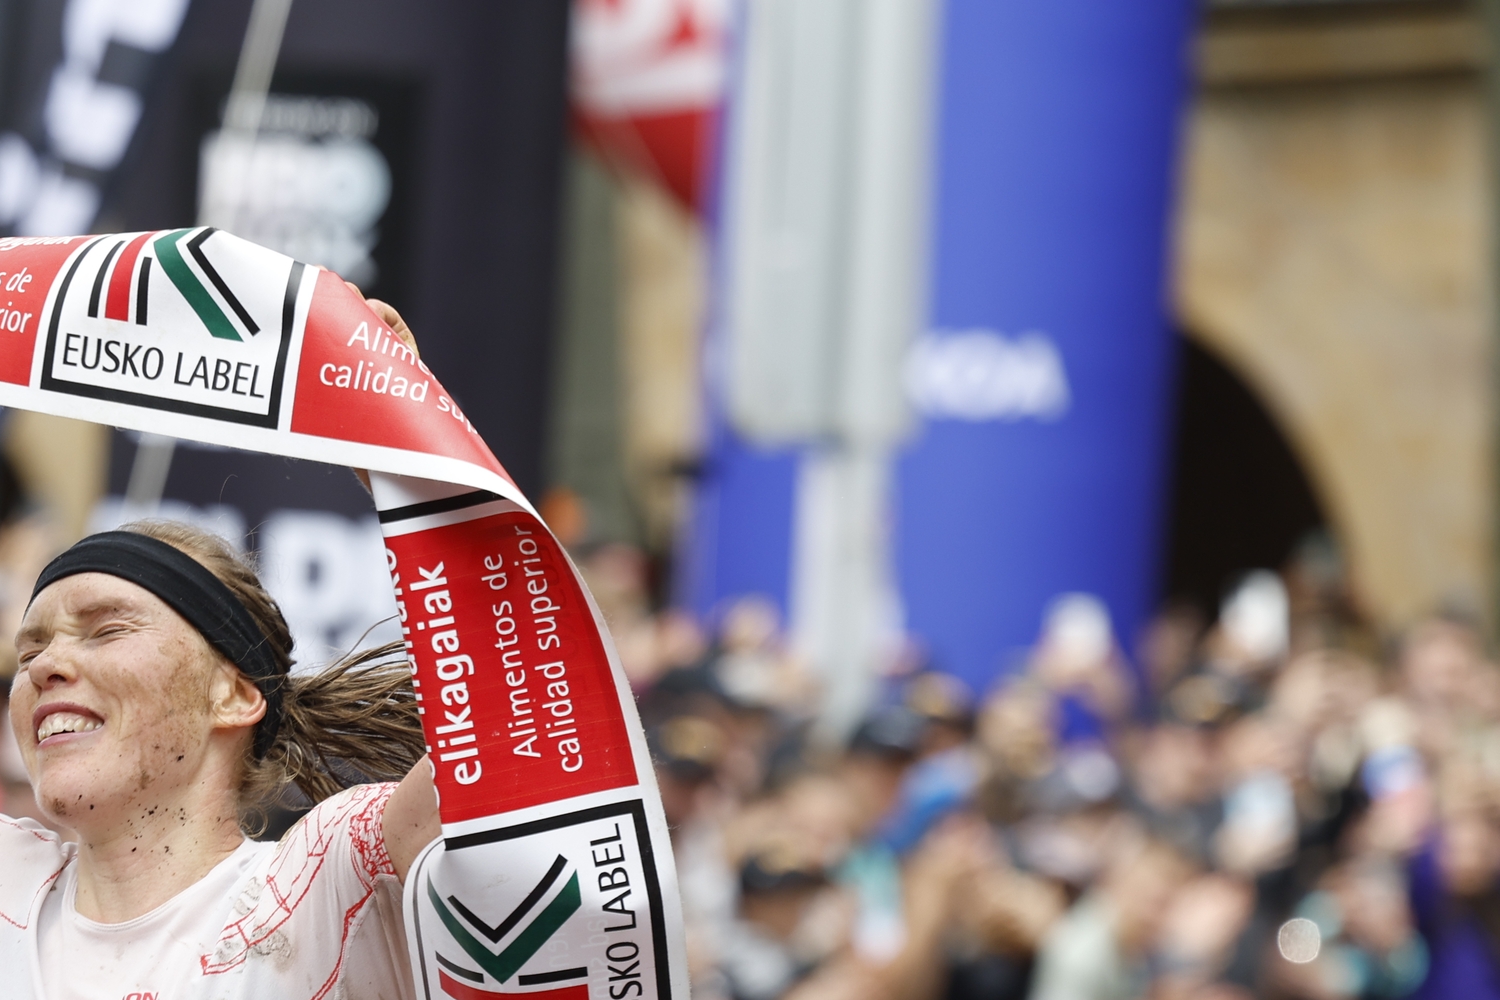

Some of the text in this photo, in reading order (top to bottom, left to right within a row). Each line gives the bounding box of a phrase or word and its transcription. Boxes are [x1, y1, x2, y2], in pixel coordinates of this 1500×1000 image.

[10, 267, 33, 293] de
[62, 333, 266, 399] EUSKO LABEL
[319, 360, 430, 403] calidad
[410, 561, 482, 785] elikagaiak
[481, 553, 541, 758] Alimentos de
[514, 525, 583, 772] calidad superior
[589, 823, 637, 932] LABEL
